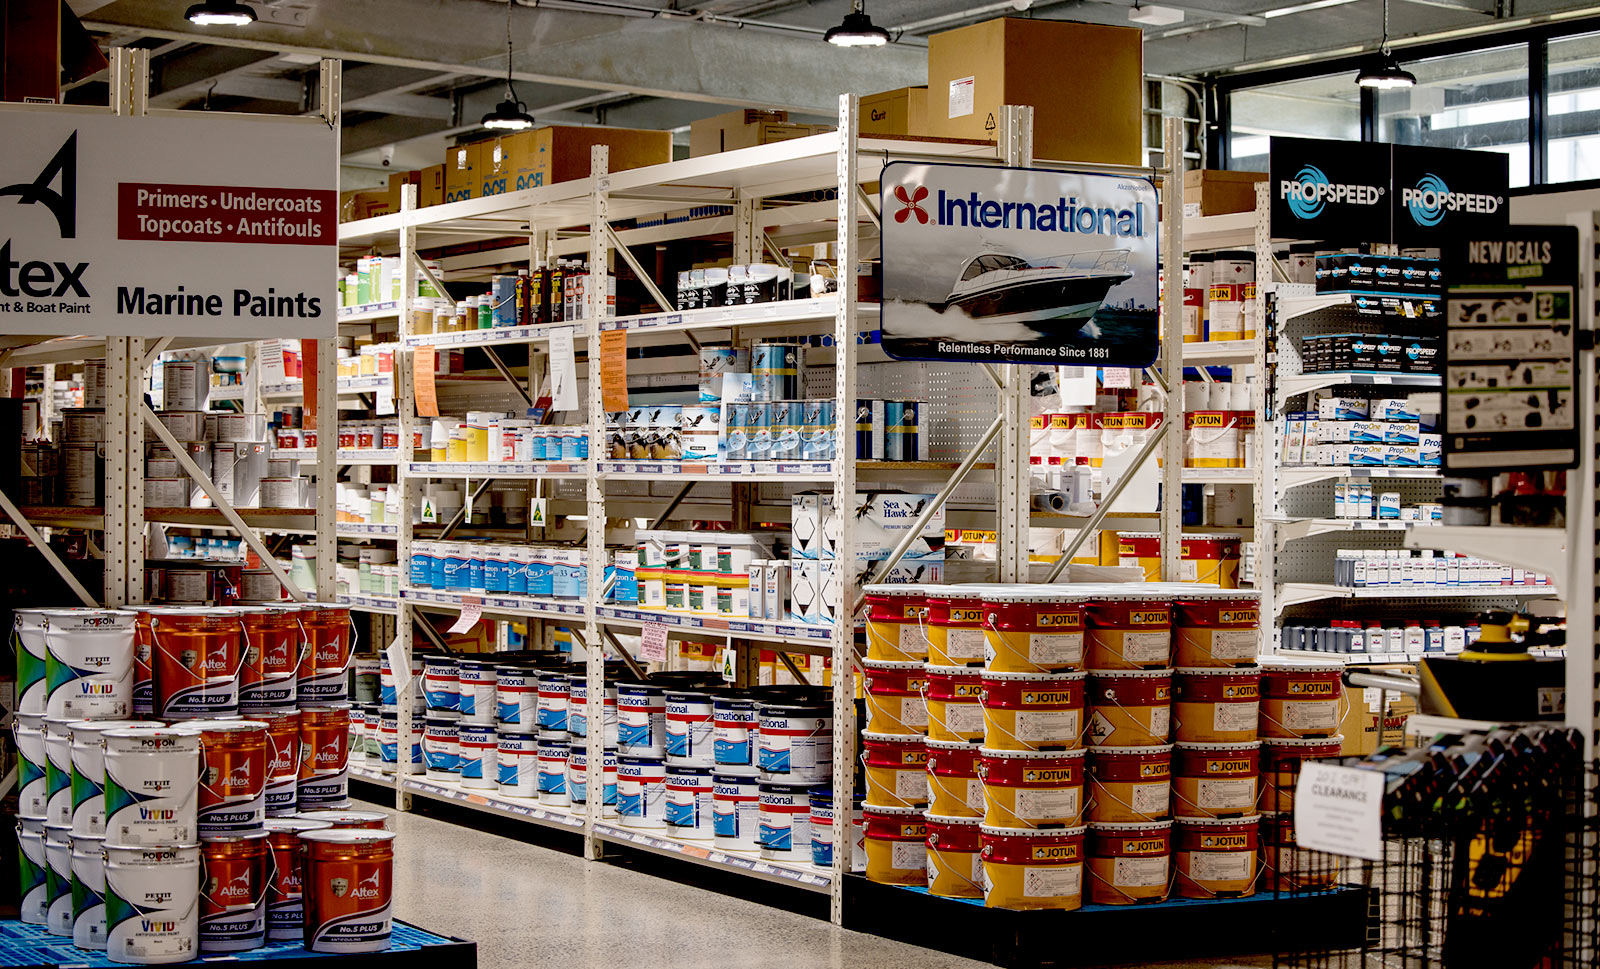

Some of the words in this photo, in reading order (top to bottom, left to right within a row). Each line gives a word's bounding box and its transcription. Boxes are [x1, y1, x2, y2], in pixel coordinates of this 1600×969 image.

[137, 189, 207, 209] Primers
[220, 192, 322, 213] Undercoats
[938, 189, 1143, 237] International
[137, 214, 222, 238] Topcoats
[236, 218, 322, 238] Antifouls
[1469, 241, 1503, 264] NEW
[1506, 241, 1551, 264] DEALS
[116, 285, 222, 316] Marine
[233, 287, 322, 318] Paints
[13, 301, 24, 312] &
[27, 302, 56, 313] Boat
[59, 302, 91, 313] Paint
[938, 342, 991, 355] Relentless
[993, 343, 1057, 357] Performance
[1058, 346, 1086, 358] Since
[1088, 347, 1110, 359] 1881
[1339, 400, 1366, 408] PropOne
[1390, 400, 1407, 408] Prop
[1353, 423, 1381, 431] PropOne
[1389, 424, 1417, 432] PropOne
[1353, 446, 1382, 454] PropOne
[884, 500, 900, 509] Sea
[883, 509, 907, 518] Hawk
[1050, 614, 1078, 625] JOTUN
[1143, 612, 1168, 623] JOTUN
[1232, 611, 1256, 621] JOTUN
[262, 655, 287, 665] Altex
[315, 652, 339, 660] Altex
[199, 659, 227, 669] Altex
[1302, 683, 1332, 693] JOTUN
[1036, 693, 1069, 703] JOTUN
[314, 753, 338, 761] Altex
[1220, 760, 1250, 771] JOTUN
[1038, 769, 1070, 780] JOTUN
[220, 777, 249, 787] Altex
[1311, 784, 1368, 803] CLEARANCE
[140, 808, 173, 820] VIVID
[1215, 836, 1246, 846] JOTUN
[1047, 846, 1076, 857] JOTUN
[1136, 841, 1164, 852] JOTUN
[220, 887, 250, 896] Altex
[350, 887, 379, 898] Altex
